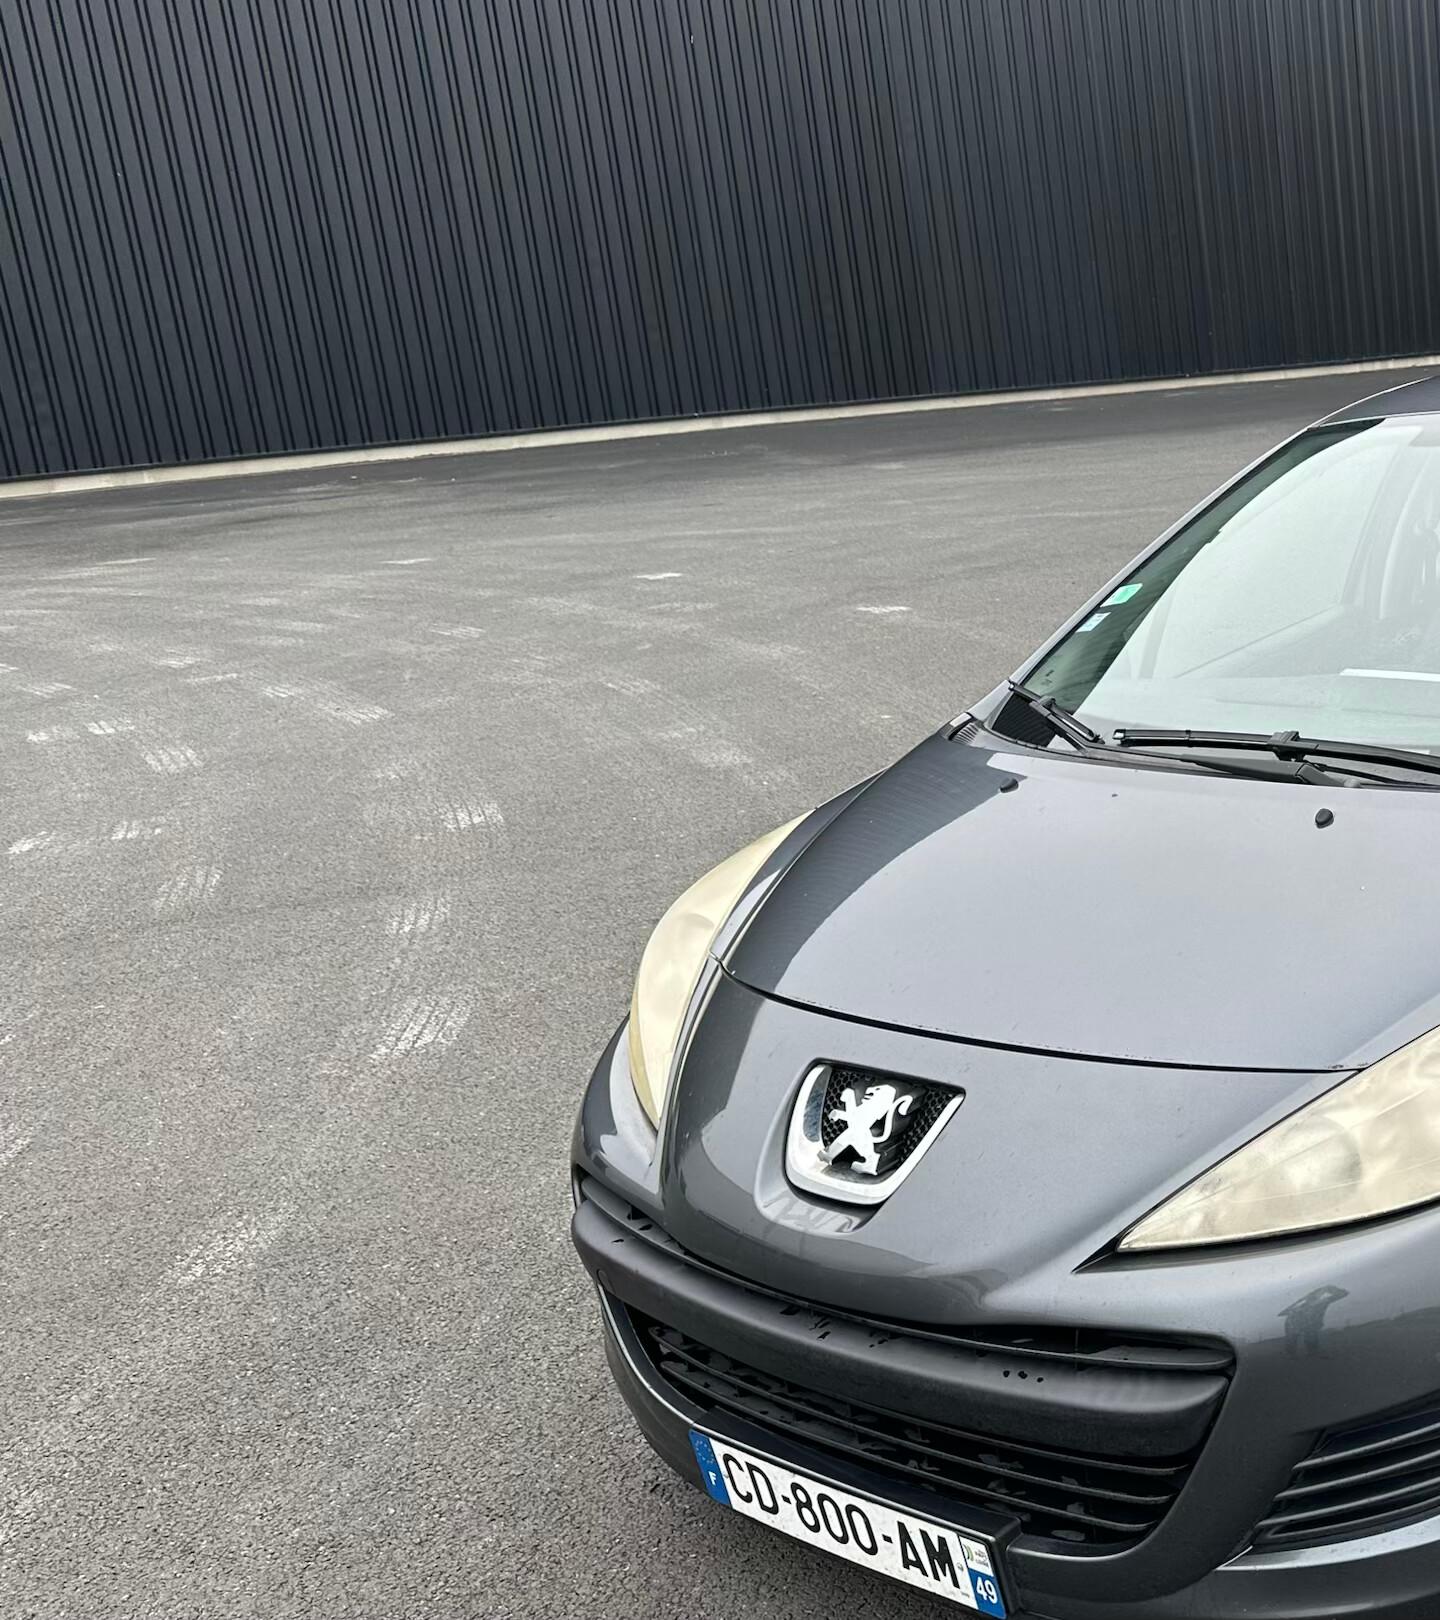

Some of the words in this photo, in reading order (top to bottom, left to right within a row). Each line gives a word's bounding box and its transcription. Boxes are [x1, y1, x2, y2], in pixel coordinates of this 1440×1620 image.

[708, 1471, 717, 1486] F
[723, 1453, 961, 1590] CD-800-AM
[976, 1576, 998, 1604] 49
